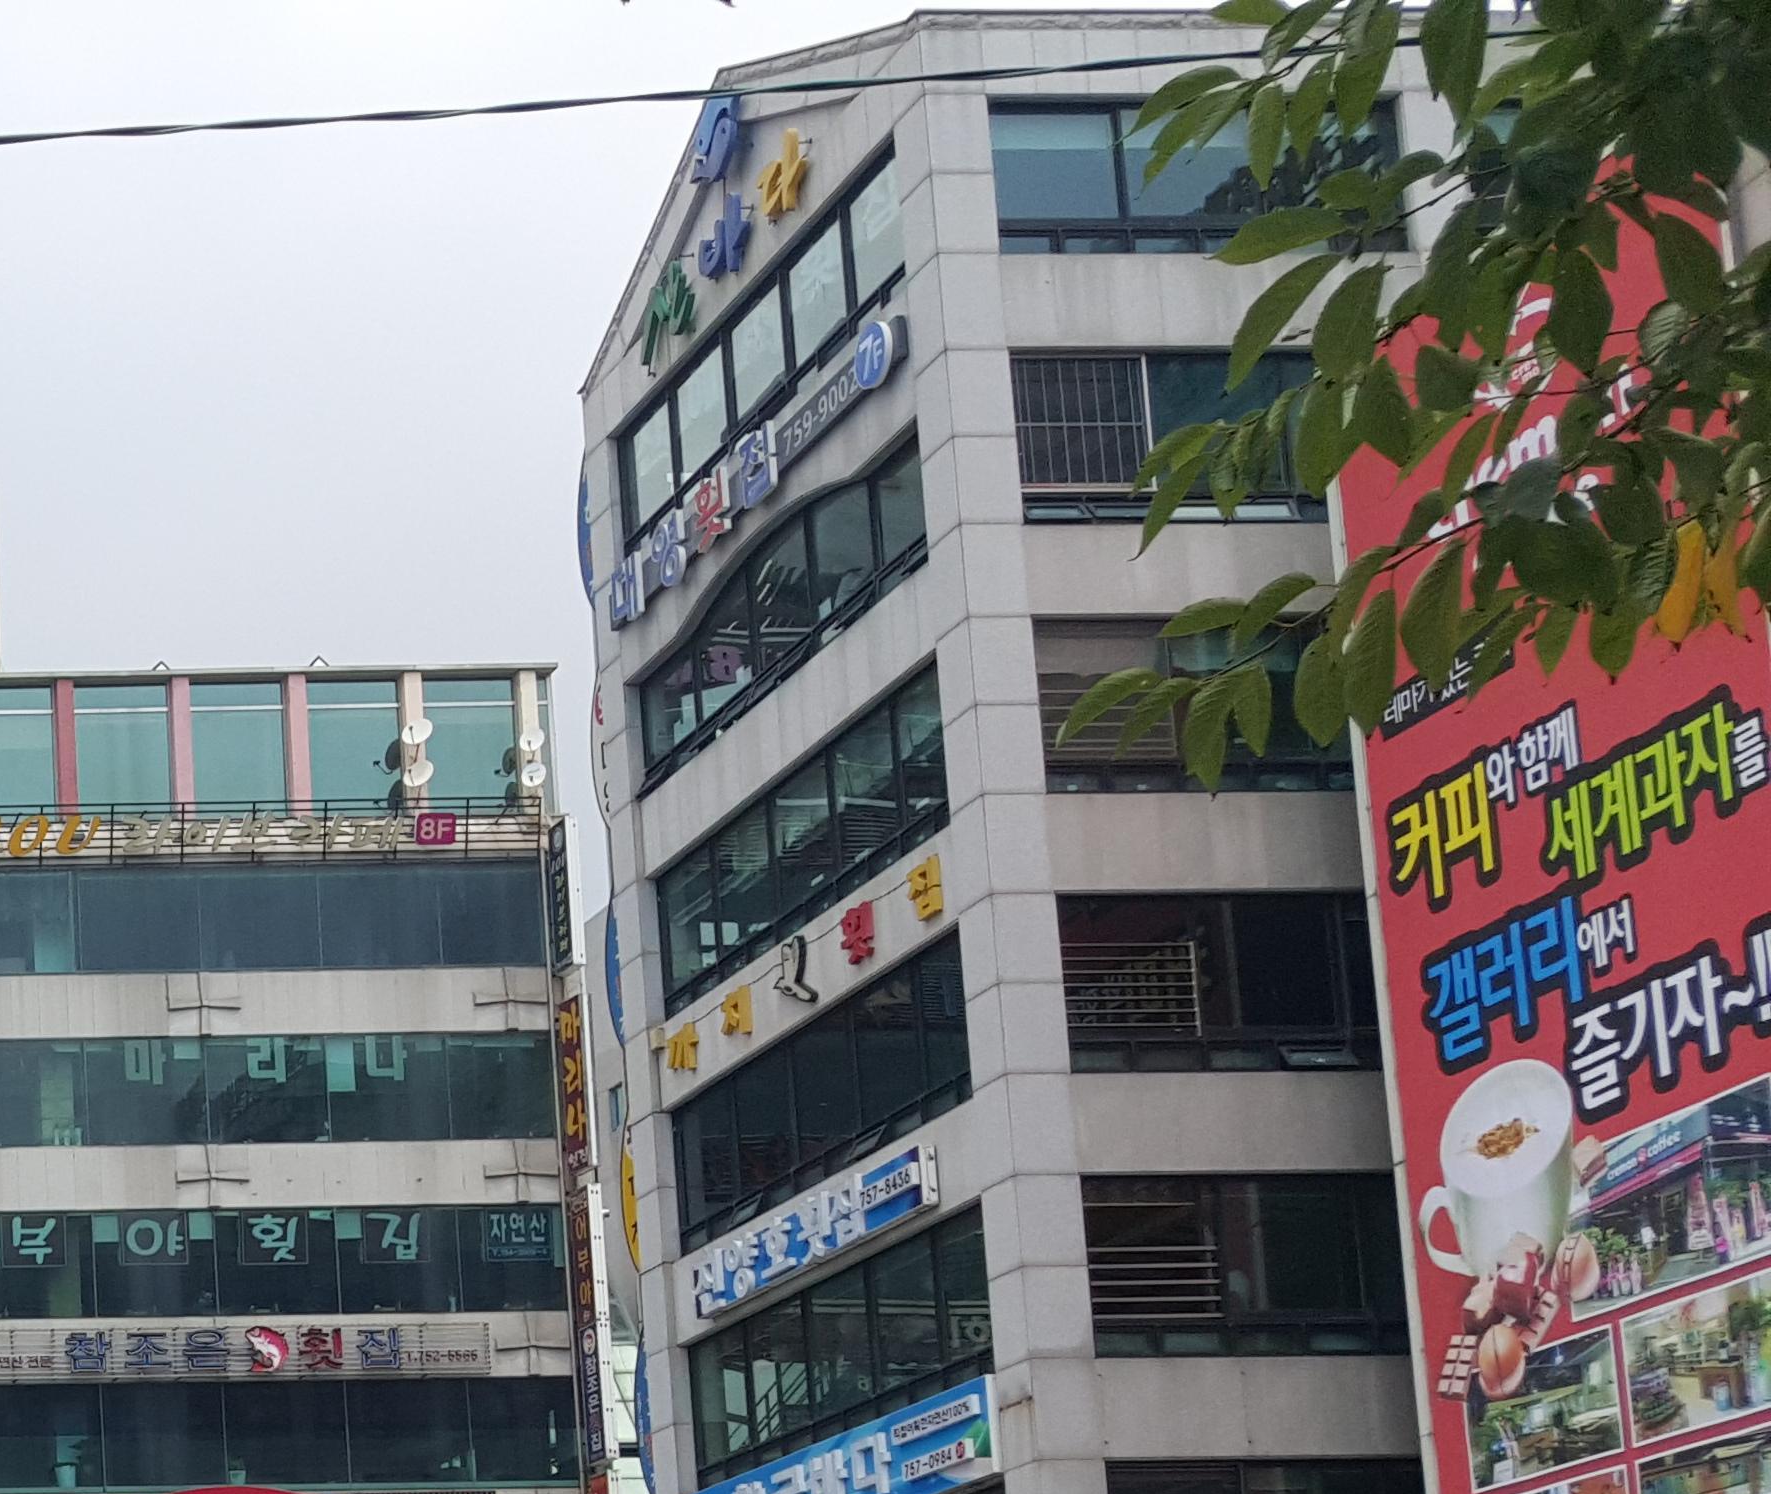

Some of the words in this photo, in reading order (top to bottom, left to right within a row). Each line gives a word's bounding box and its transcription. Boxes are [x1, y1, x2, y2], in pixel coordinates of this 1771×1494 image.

[419, 817, 453, 842] 8F
[489, 1214, 547, 1243] 자연산
[64, 1332, 229, 1375] 참조은
